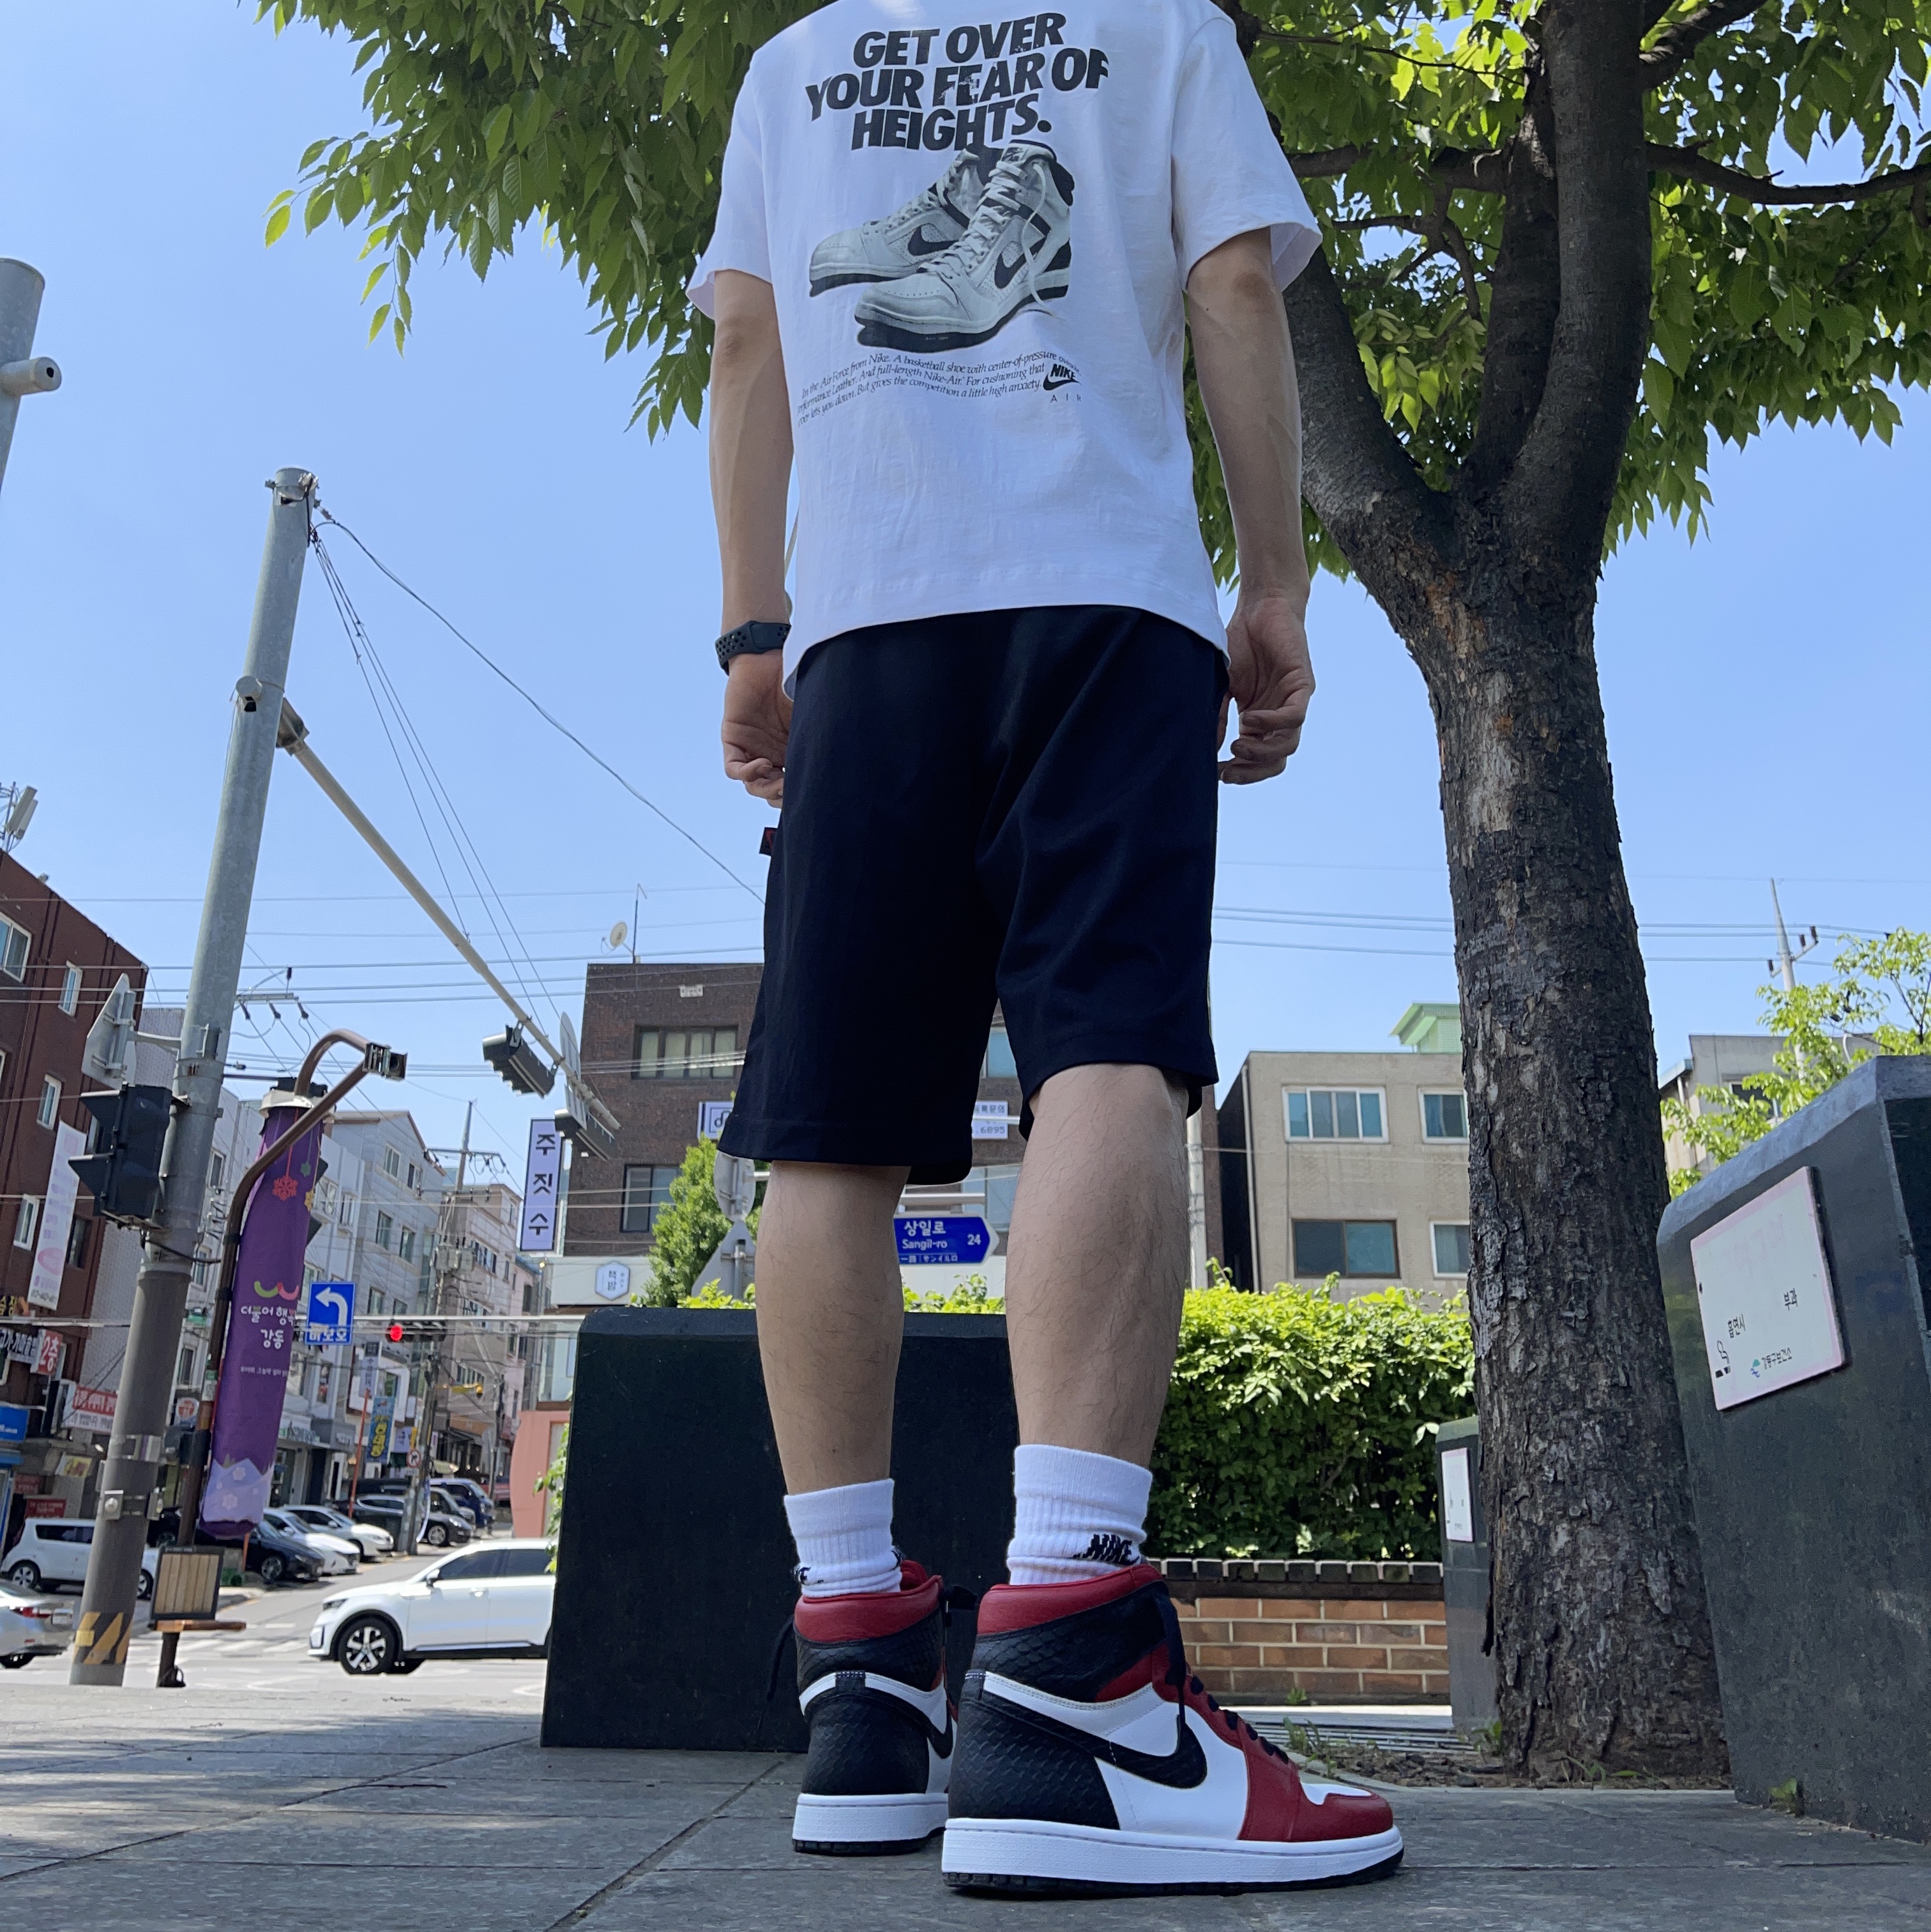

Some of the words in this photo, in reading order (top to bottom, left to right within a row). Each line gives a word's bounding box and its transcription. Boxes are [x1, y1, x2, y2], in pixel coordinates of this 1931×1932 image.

[853, 29, 940, 68] GET
[945, 13, 1066, 63] OVER
[805, 68, 924, 121] YOUR
[932, 52, 1045, 107] FEAR
[1050, 48, 1109, 91] OF
[851, 93, 1052, 151] HEIGHTS.
[820, 375, 832, 388] Air
[832, 367, 849, 383] Force
[851, 360, 867, 377] from
[868, 353, 890, 365] Nike.
[893, 354, 902, 363] A
[904, 356, 945, 371] basketball
[946, 362, 966, 373] shoe
[967, 363, 987, 374] with
[988, 351, 1057, 372] center-of-pressure
[859, 366, 875, 381] And
[877, 364, 921, 379] full-length
[966, 376, 981, 386] For
[982, 369, 1027, 384] cushioning
[1029, 363, 1045, 376] that
[1050, 363, 1076, 379] NIKE
[822, 402, 834, 416] you
[835, 391, 856, 406] down.
[857, 382, 869, 395] But
[870, 379, 892, 393] gives
[893, 376, 908, 385] the
[909, 379, 958, 397] competition
[969, 386, 988, 398] little
[989, 384, 1007, 397] high
[1008, 379, 1041, 392] anxiety.
[1050, 393, 1082, 403] AIR
[529, 1134, 556, 1236] 주짓수
[904, 1220, 946, 1236] 상일로
[967, 1233, 981, 1245] 24
[902, 1238, 948, 1251] Sangil-ro
[1783, 1288, 1798, 1311] 부과
[241, 1305, 274, 1323] 더불어
[1727, 1314, 1746, 1339] 흡연시
[261, 1329, 284, 1350] 강동
